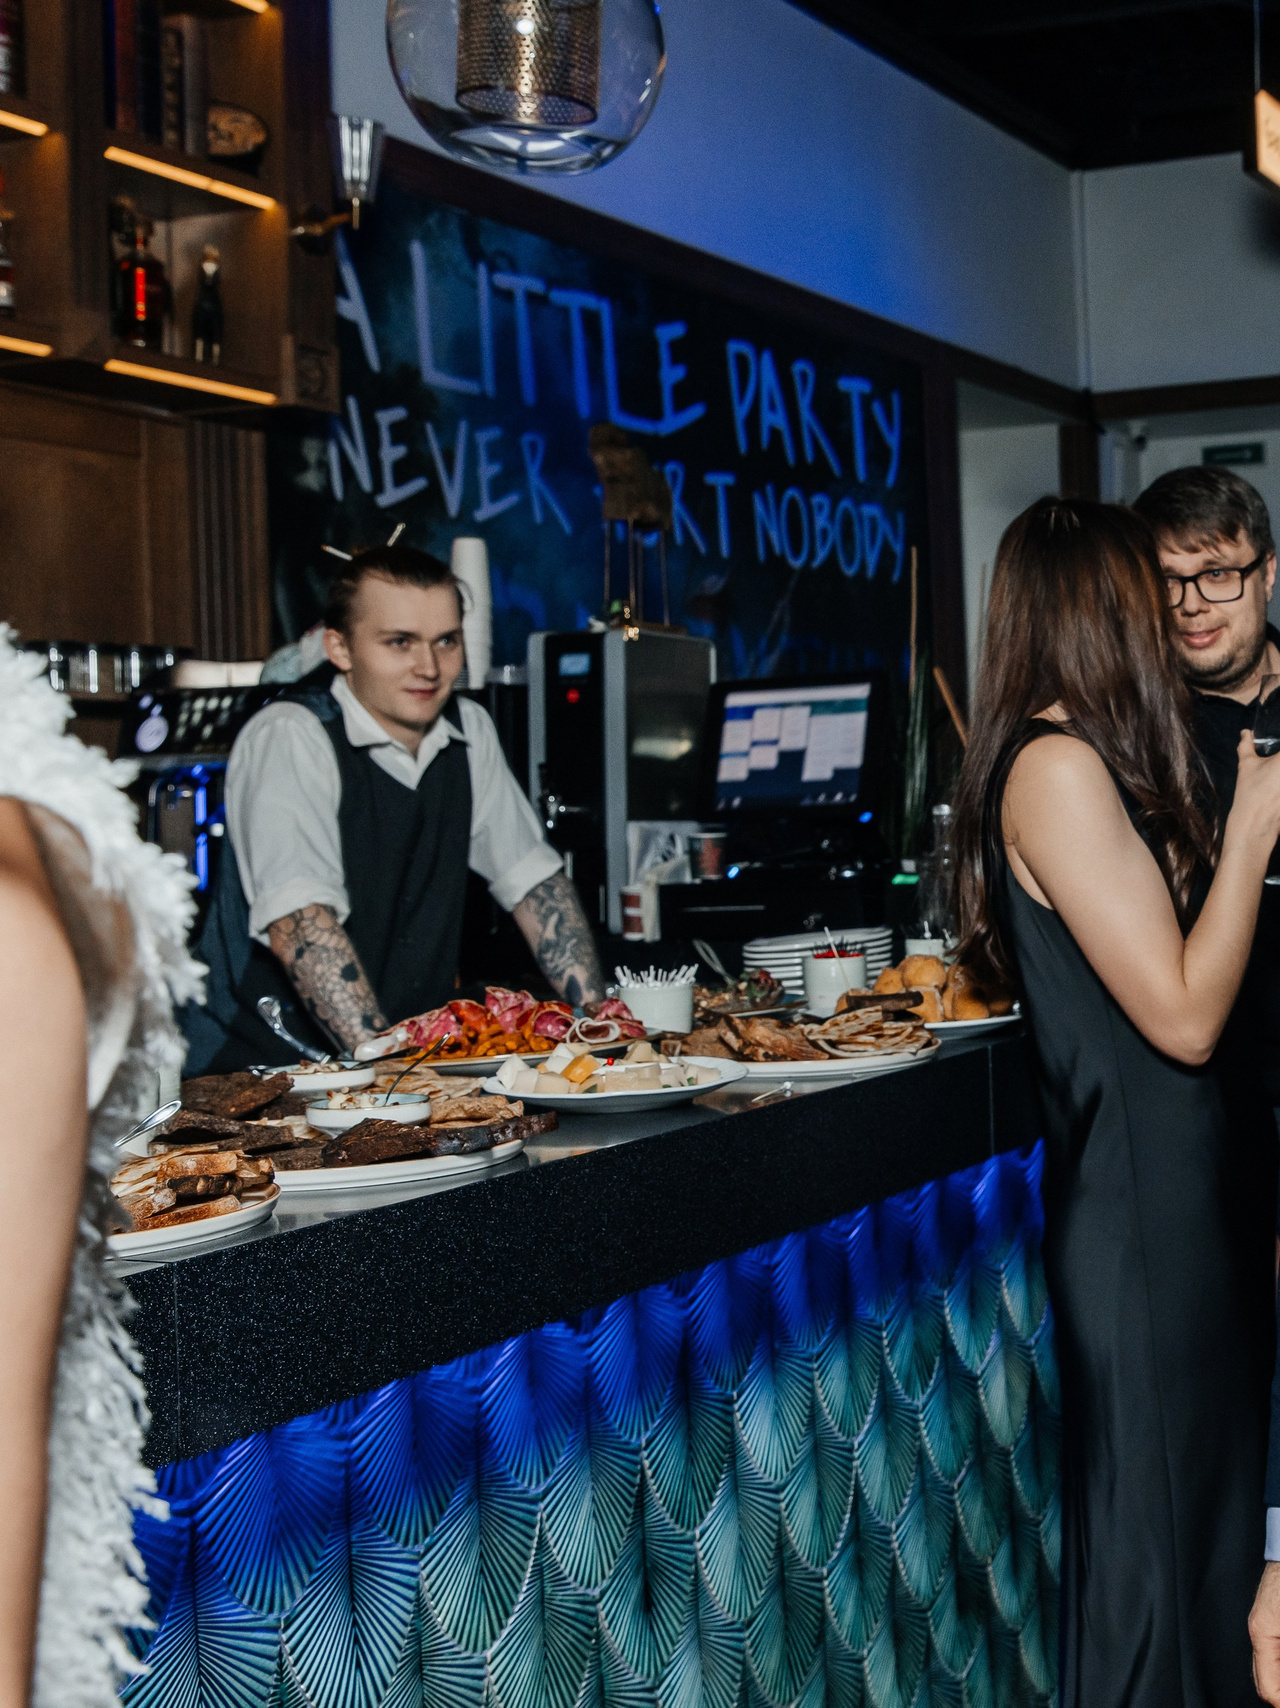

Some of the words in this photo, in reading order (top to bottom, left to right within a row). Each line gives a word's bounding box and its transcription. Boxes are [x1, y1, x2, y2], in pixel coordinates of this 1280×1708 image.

[410, 240, 706, 436] LITTLE
[726, 339, 901, 488] PARTY
[328, 395, 573, 536] NEVER
[594, 460, 738, 558] RT
[752, 484, 905, 583] NOBODY
